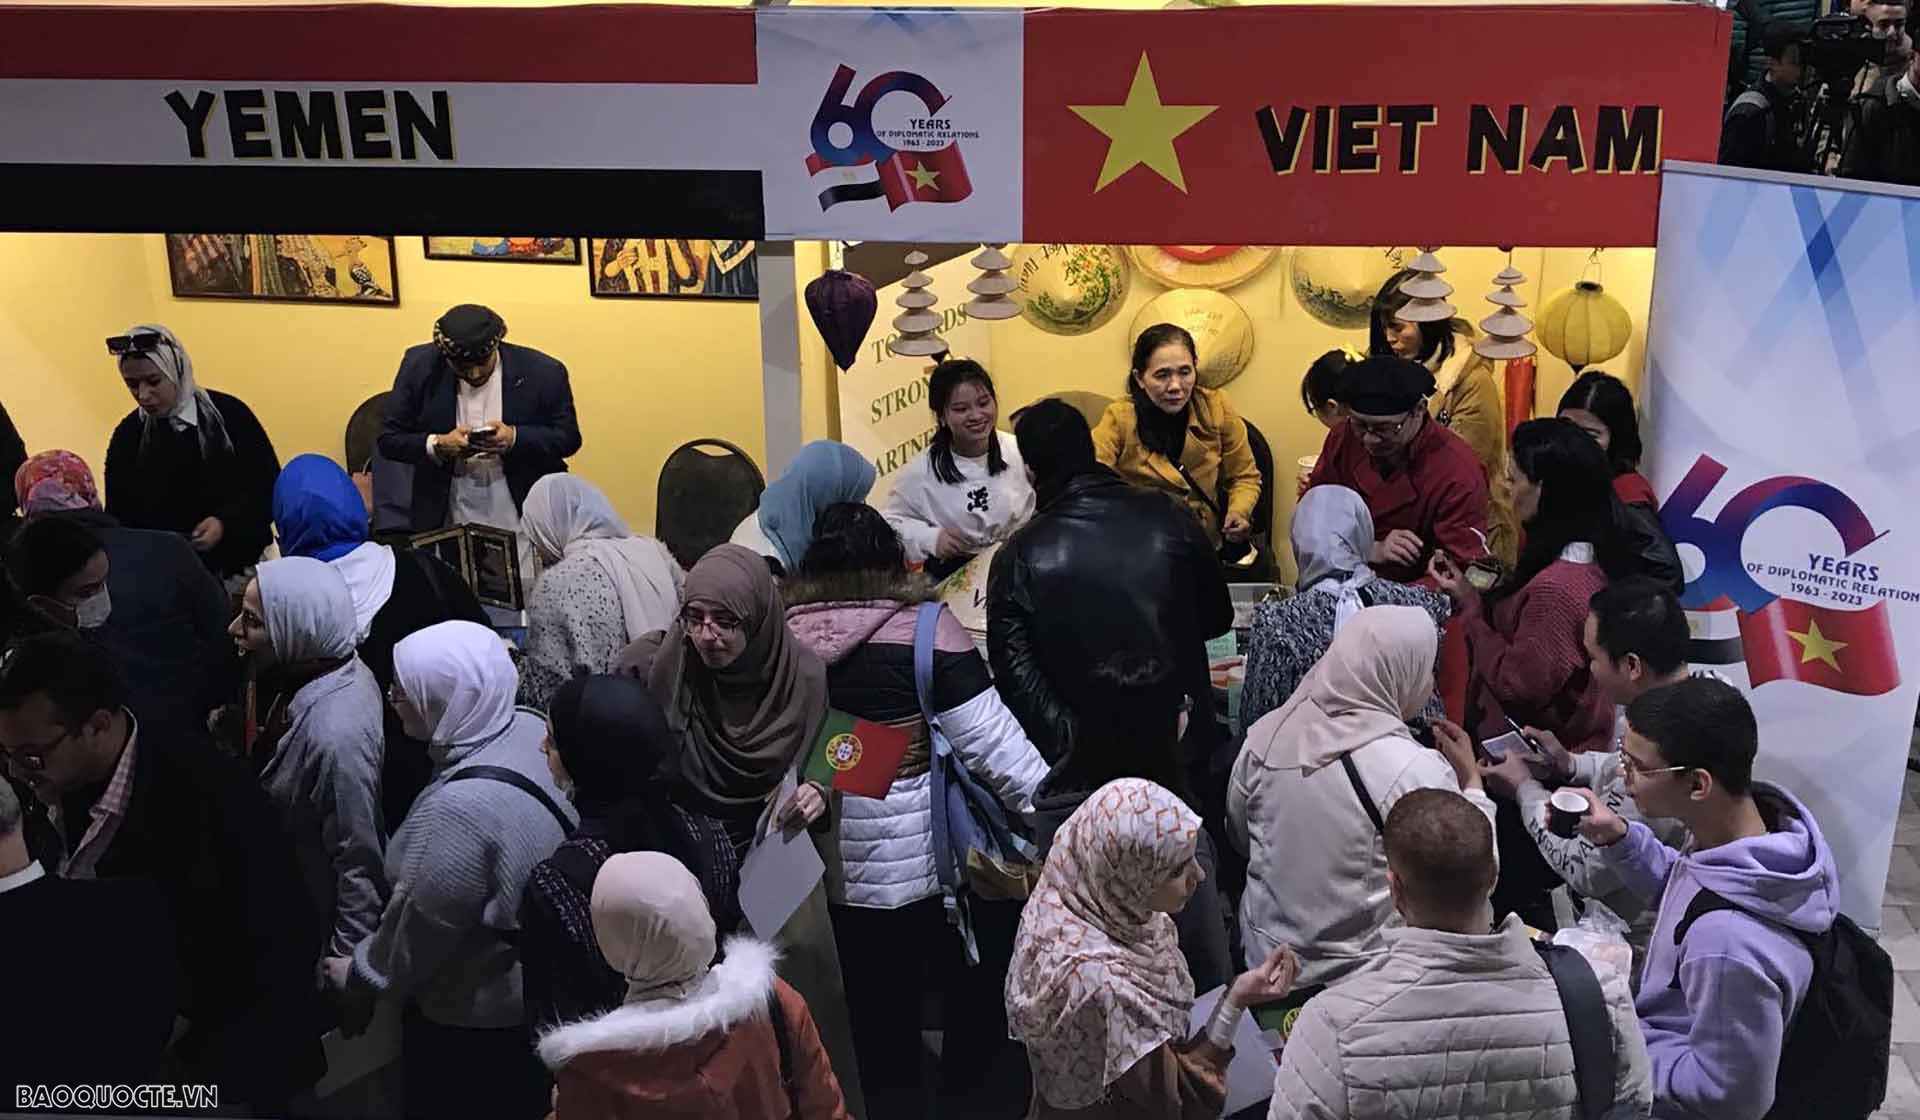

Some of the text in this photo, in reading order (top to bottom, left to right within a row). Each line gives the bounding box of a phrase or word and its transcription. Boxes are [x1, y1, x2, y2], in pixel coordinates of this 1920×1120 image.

[163, 88, 456, 161] YEMEN
[877, 130, 980, 139] OF DIPLOMATIC RELATIONS
[910, 118, 952, 131] YEARS
[902, 139, 920, 147] 1963
[926, 139, 945, 147] 2023
[1255, 103, 1662, 176] VIET NAM
[1746, 562, 1764, 575] OF
[1767, 565, 1847, 589] DIPLOMATIC
[1808, 552, 1880, 582] YEARS
[1791, 582, 1820, 597] 1963
[1831, 590, 1863, 606] 2023
